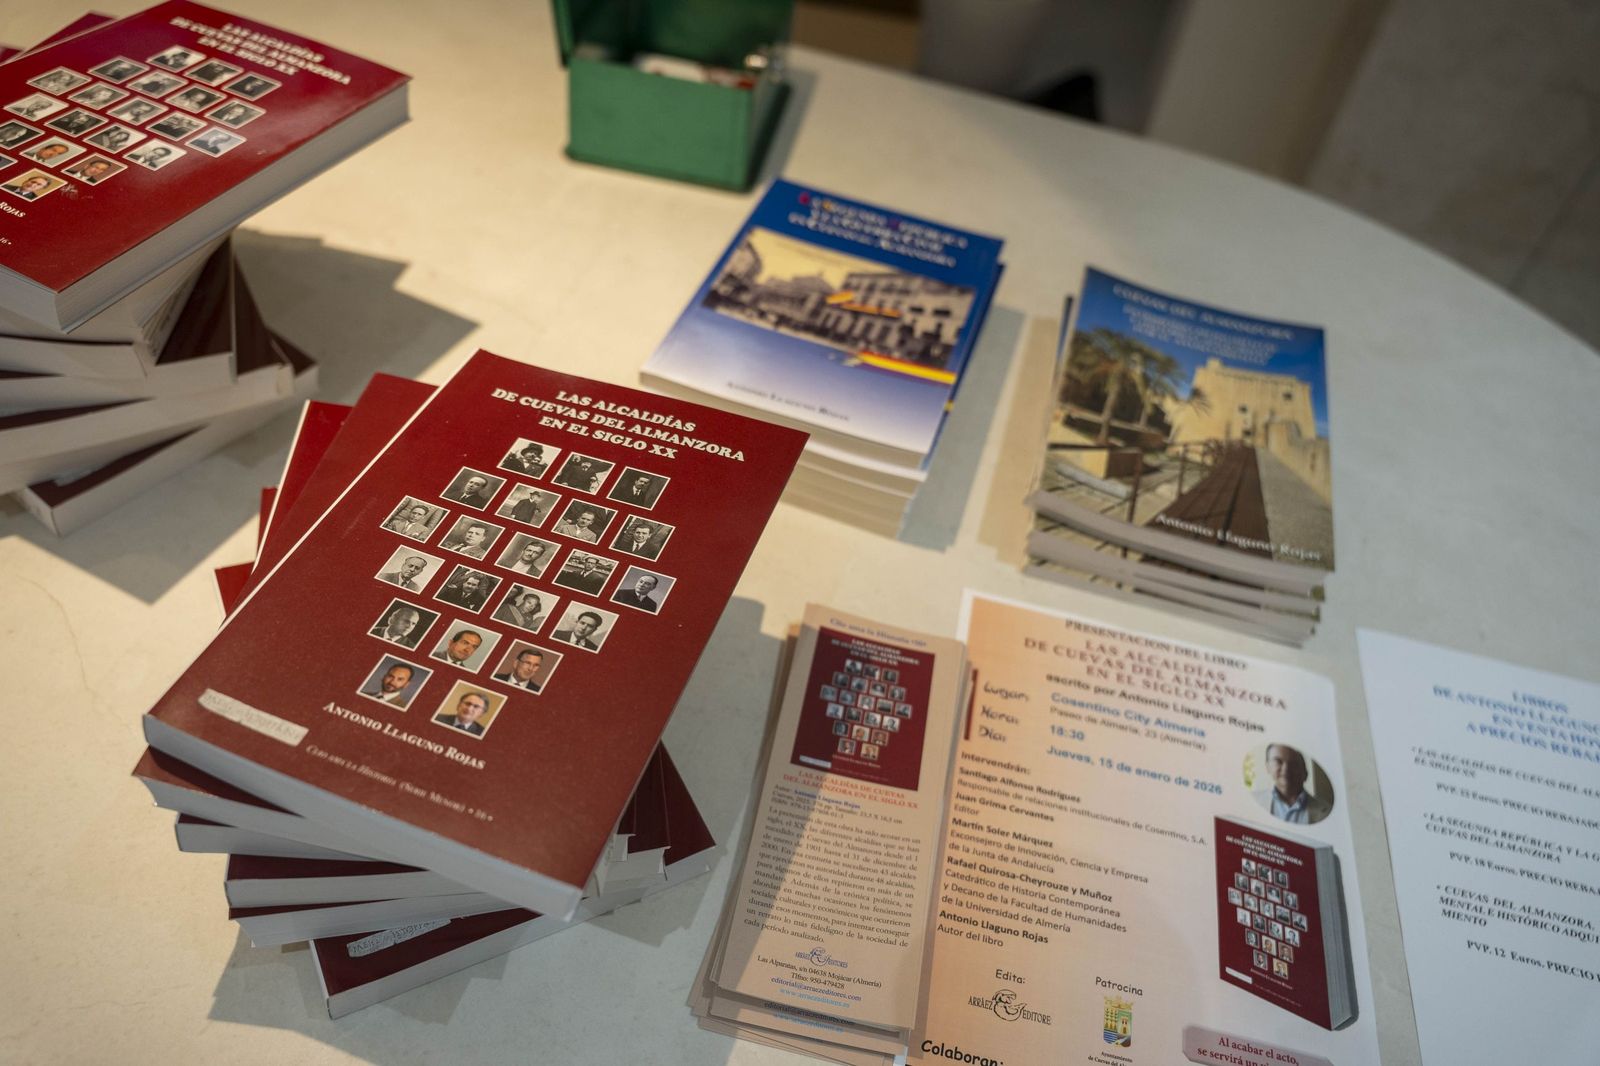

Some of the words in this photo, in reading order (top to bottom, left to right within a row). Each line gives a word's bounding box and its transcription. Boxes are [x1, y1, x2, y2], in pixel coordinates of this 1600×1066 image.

[490, 387, 519, 402] DE
[518, 395, 590, 420] CUEVAS
[589, 413, 626, 430] DEL
[627, 423, 744, 461] ALMANZORA
[555, 390, 592, 406] LAS
[591, 399, 696, 432] ALCALDÍAS
[538, 415, 567, 429] EN
[566, 422, 589, 436] EL
[591, 429, 647, 450] SIGLO
[647, 443, 678, 459] XX
[1155, 513, 1214, 537] Antonio
[1280, 544, 1321, 560] Rojas
[1023, 637, 1046, 651] DE
[1052, 644, 1124, 670] CUEVAS
[1131, 663, 1163, 680] DEL
[1172, 674, 1286, 709] ALMANZORA
[1085, 639, 1117, 655] LAS
[1125, 650, 1225, 682] ALCALDÍAS
[1085, 664, 1108, 679] EN
[1115, 671, 1134, 685] EL
[1141, 678, 1197, 700] SIGLO
[1204, 694, 1223, 707] XX
[1050, 691, 1120, 716] Cosentino
[1123, 709, 1150, 725] City
[1153, 717, 1205, 737] Almería
[1093, 685, 1115, 695] por
[1118, 690, 1169, 709] Antonio
[1172, 703, 1224, 722] Llaguno
[1228, 716, 1264, 732] Rojas
[322, 701, 382, 730] ANTONIO
[382, 722, 444, 754] LLAGUNO
[444, 745, 485, 769] ROJAS
[1050, 724, 1085, 741] 18:30
[959, 766, 998, 782] Santiago
[999, 776, 1034, 791] Alfonso
[960, 751, 1030, 775] Intervendrán:
[1099, 757, 1113, 768] 15
[1115, 762, 1132, 773] de
[1134, 767, 1171, 782] enero
[1173, 775, 1189, 787] de
[1193, 779, 1222, 795] 2026
[955, 791, 976, 802] Juan
[978, 797, 1006, 810] Grima
[1008, 804, 1054, 822] Cervantes
[986, 825, 1009, 837] Soler
[1011, 831, 1053, 848] Márquez
[1425, 823, 1468, 840] CUEVAS
[1470, 833, 1491, 846] DEL
[1494, 839, 1561, 864] ALMANZORA
[948, 841, 960, 850] de
[961, 844, 970, 853] la
[971, 847, 995, 859] Junta
[997, 853, 1009, 862] de
[1010, 856, 1054, 873] Andalucía
[949, 829, 1002, 848] Exconsejero
[1003, 842, 1016, 851] de
[1017, 845, 1067, 864] Innovación,
[1069, 857, 1101, 872] Ciencia
[1110, 867, 1148, 883] Empresa
[944, 868, 996, 887] Catedrático
[997, 881, 1010, 891] de
[1011, 884, 1046, 900] Historia
[1048, 893, 1120, 918] Contemporánea
[946, 855, 976, 870] Rafael
[978, 863, 1069, 892] Quirosa-Cheyrouze
[1071, 887, 1077, 895] y
[1079, 887, 1112, 902] Muñoz
[941, 894, 953, 904] de
[954, 897, 963, 907] la
[965, 900, 1019, 920] Universidad
[1020, 914, 1033, 924] de
[1034, 917, 1071, 933] Almería
[943, 882, 949, 890] y
[950, 882, 985, 898] Decano
[985, 892, 998, 902] de
[999, 894, 1008, 904] la
[1010, 897, 1049, 914] Facultad
[1050, 907, 1062, 917] de
[1064, 910, 1127, 932] Humanidades
[1439, 896, 1486, 915] MENTAL
[1488, 908, 1495, 917] E
[1497, 909, 1560, 933] HISTÓRICO
[1445, 885, 1489, 903] CUEVAS
[1493, 897, 1515, 910] DEL
[744, 917, 761, 926] cada
[790, 929, 824, 943] analizado.
[936, 923, 963, 936] Autor
[965, 930, 980, 941] del
[981, 934, 1004, 947] libro
[938, 909, 979, 926] Antonio
[980, 919, 1019, 936] Llaguno
[1021, 929, 1048, 943] Rojas
[1441, 909, 1487, 927] MIENTO
[758, 955, 768, 964] Las
[808, 968, 827, 977] 04638
[995, 969, 1025, 984] Edita:
[1494, 948, 1505, 958] 12
[1547, 961, 1594, 980] PRECIO
[1095, 976, 1143, 996] Patrocina
[921, 1040, 1004, 1066] Colaboran:
[1198, 1047, 1207, 1057] se
[1209, 1052, 1243, 1066] servirá
[1219, 1037, 1229, 1047] Al
[1232, 1042, 1263, 1056] acabar
[1266, 1049, 1274, 1059] el
[1276, 1053, 1299, 1066] acto,
